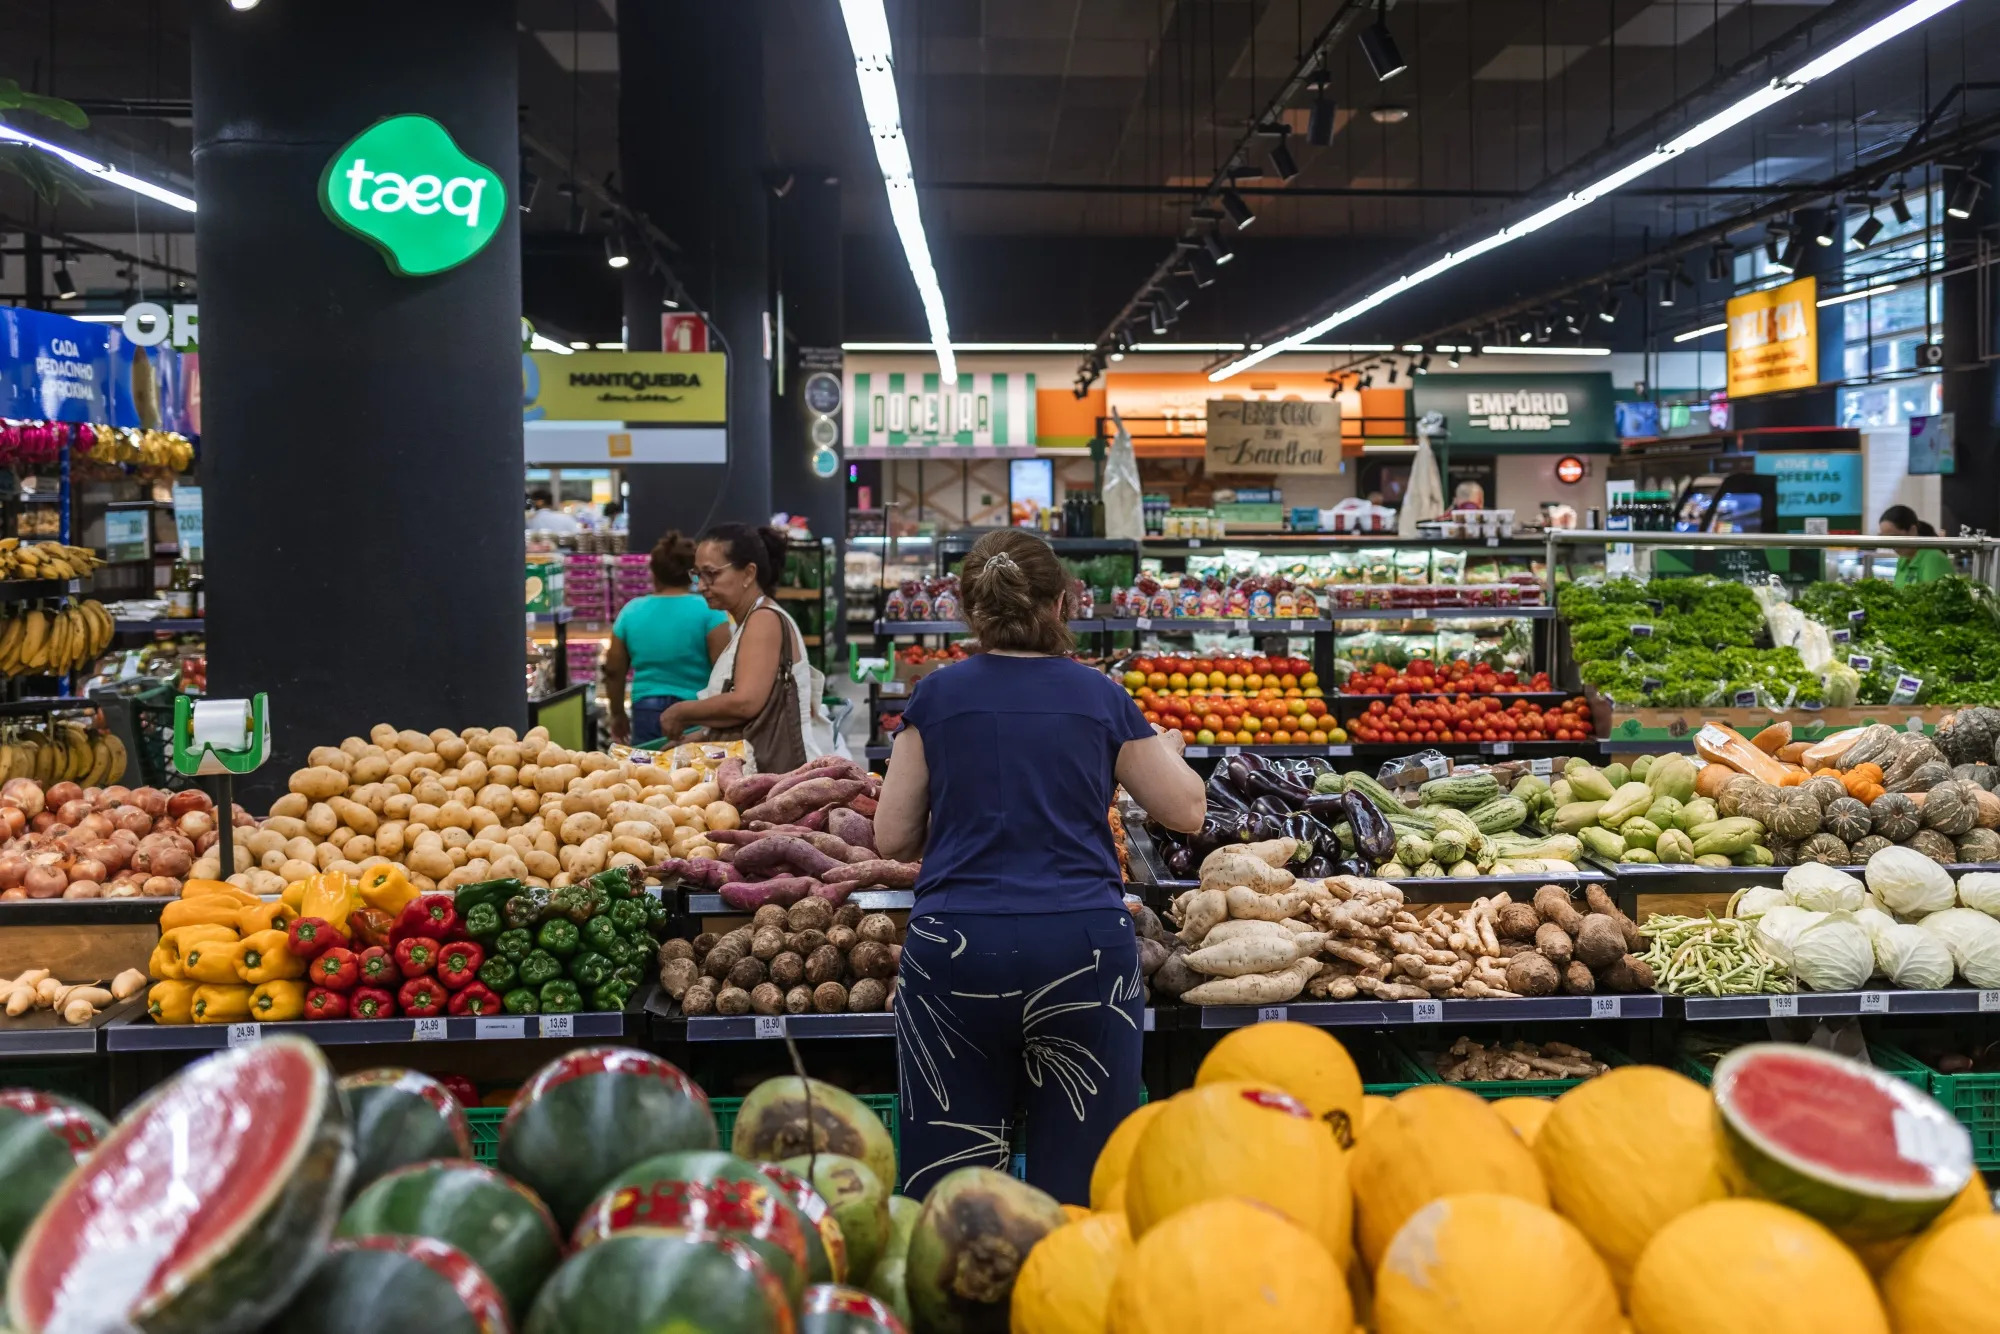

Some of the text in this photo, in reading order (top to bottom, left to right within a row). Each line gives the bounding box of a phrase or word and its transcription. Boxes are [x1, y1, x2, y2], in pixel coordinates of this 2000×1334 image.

[346, 158, 487, 227] taeq
[51, 338, 79, 358] CADA
[36, 358, 94, 381] PEDACINHO
[569, 372, 701, 391] MANTIQUEIRA
[1467, 389, 1569, 415] EMPÓRIO
[1488, 415, 1552, 430] DE FRIOS
[1805, 491, 1843, 505] APP
[1775, 997, 1792, 1008] 19,99
[1866, 994, 1880, 1003] 8,99
[1985, 992, 1999, 1003] 8,99
[1418, 1004, 1436, 1015] 24,99
[1596, 999, 1613, 1010] 16,69
[1265, 1009, 1279, 1020] 8,39
[420, 1019, 439, 1031] 24,99
[549, 1017, 568, 1029] 13,69
[762, 1018, 780, 1029] 18,90
[236, 1026, 255, 1038] 24,99
